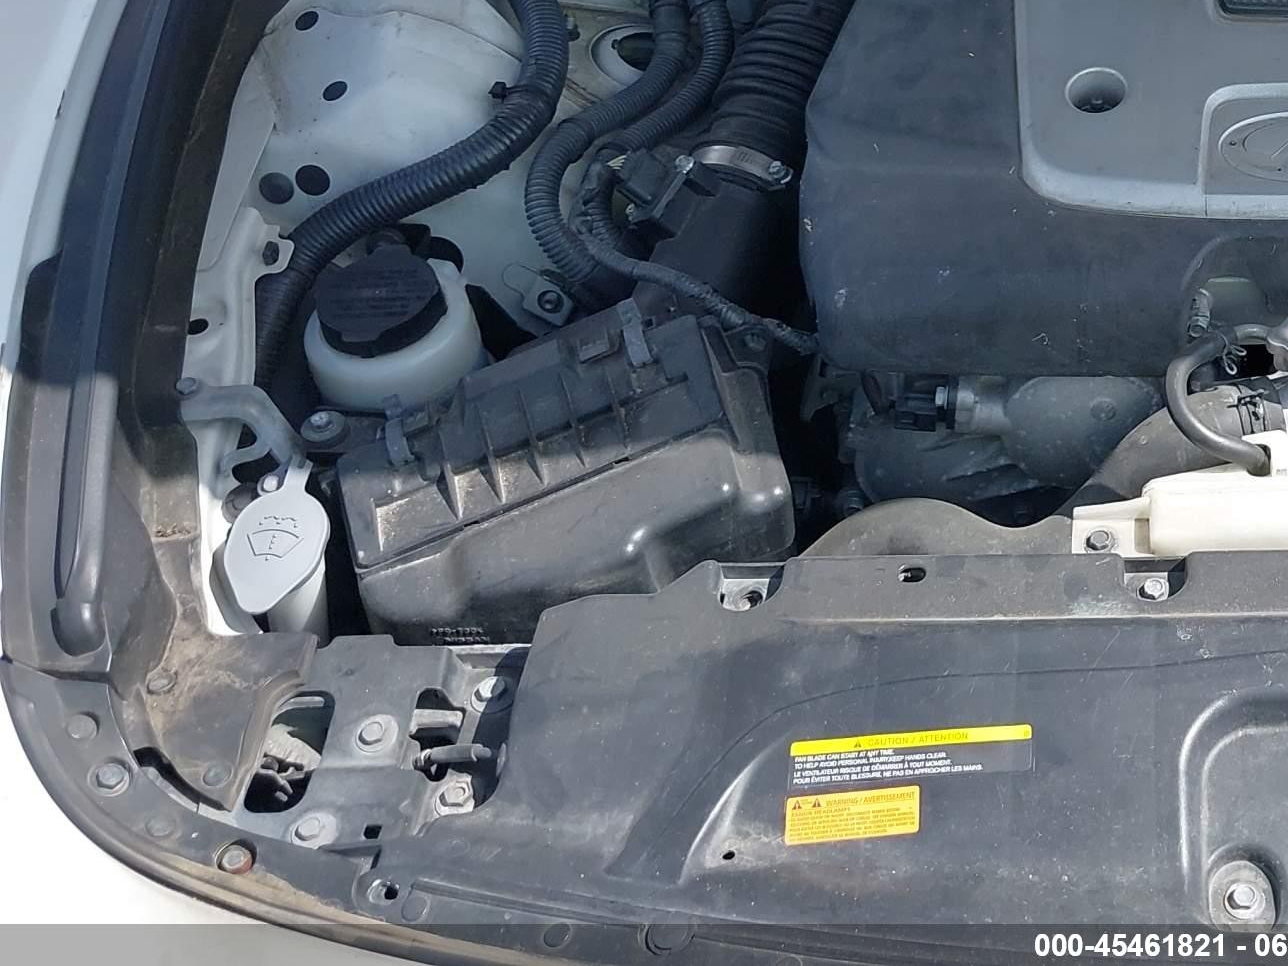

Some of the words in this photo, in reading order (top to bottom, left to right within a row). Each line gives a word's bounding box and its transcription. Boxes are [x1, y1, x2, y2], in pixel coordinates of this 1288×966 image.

[868, 737, 908, 746] CAUTION
[919, 732, 969, 744] ATTENTION
[826, 797, 858, 807] WARNING
[863, 791, 915, 803] AVERTISSEMENT
